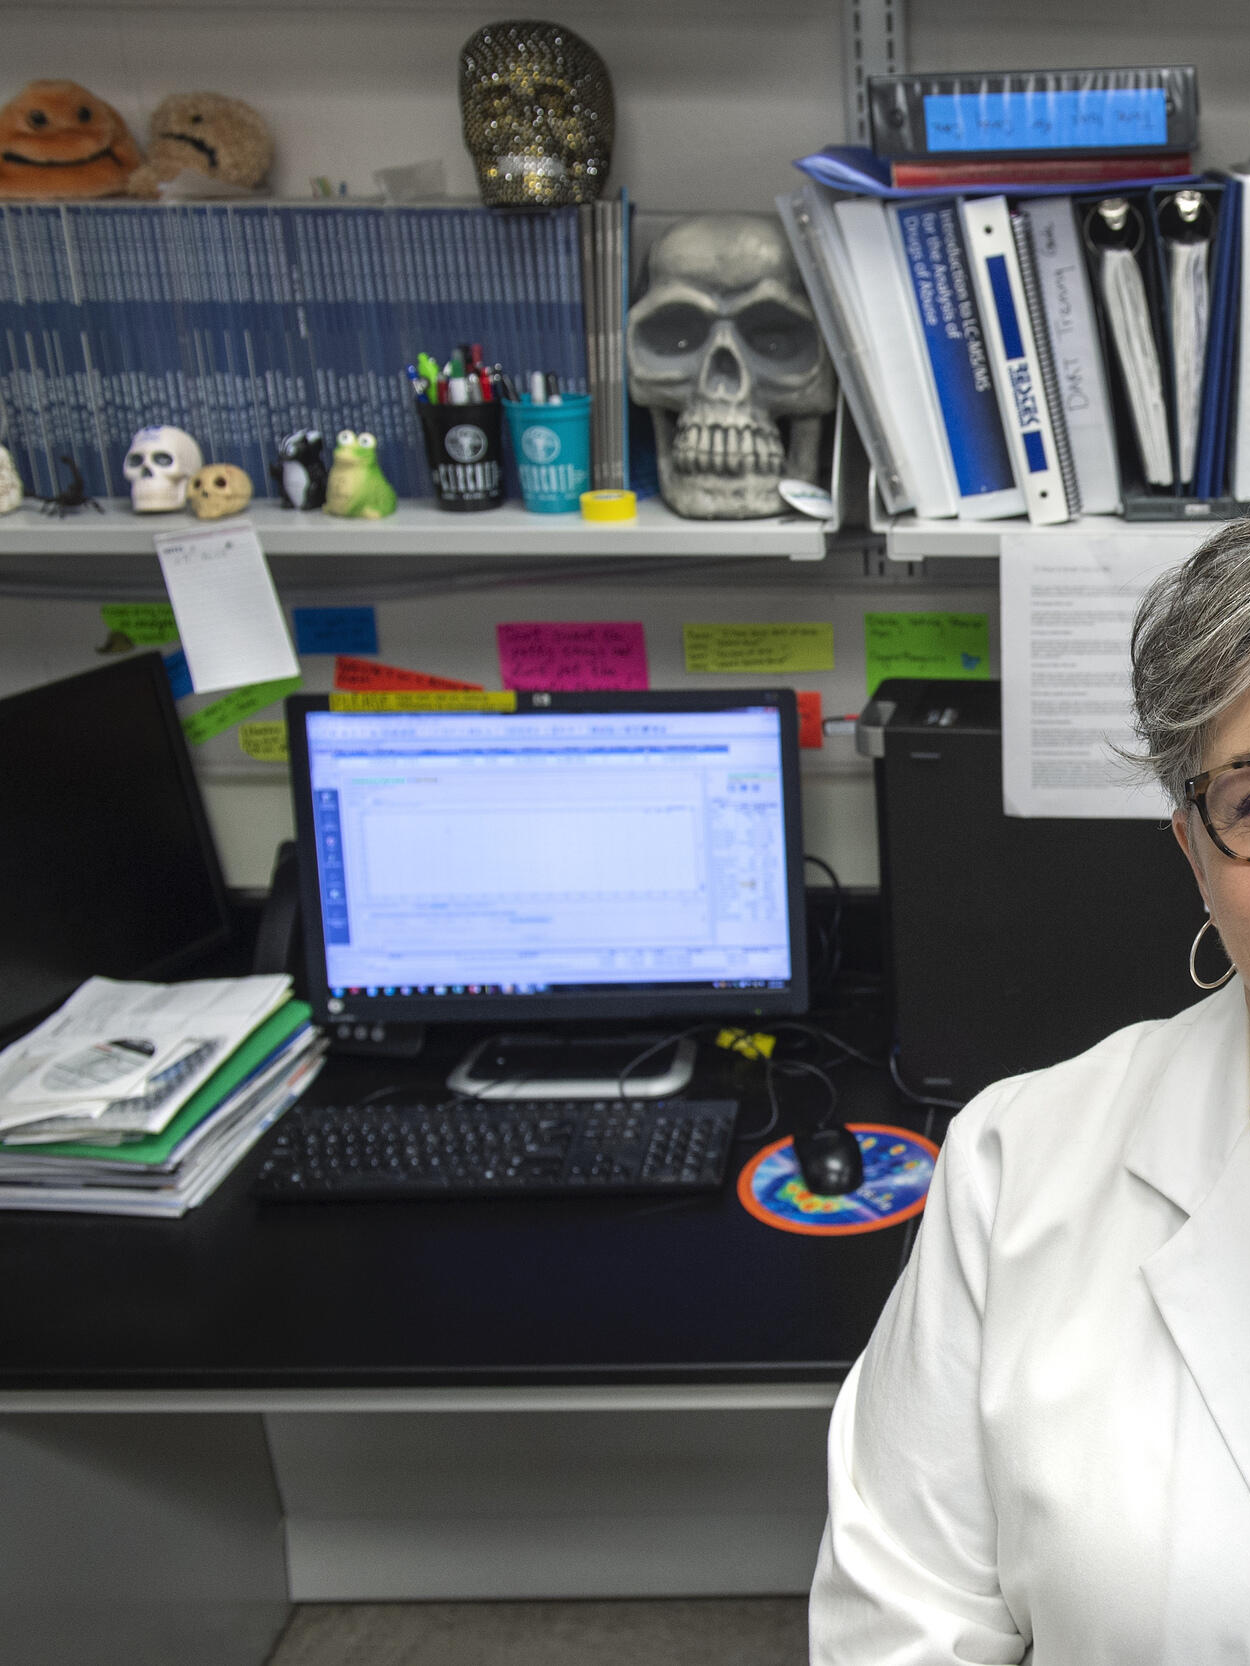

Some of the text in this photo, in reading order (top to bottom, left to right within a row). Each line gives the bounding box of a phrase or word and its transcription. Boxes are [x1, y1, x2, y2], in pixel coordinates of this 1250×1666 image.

[903, 215, 939, 327] Drugs of Abuse
[920, 212, 963, 340] for the Analysis of
[939, 209, 992, 393] Introduction to LC-MS/MS
